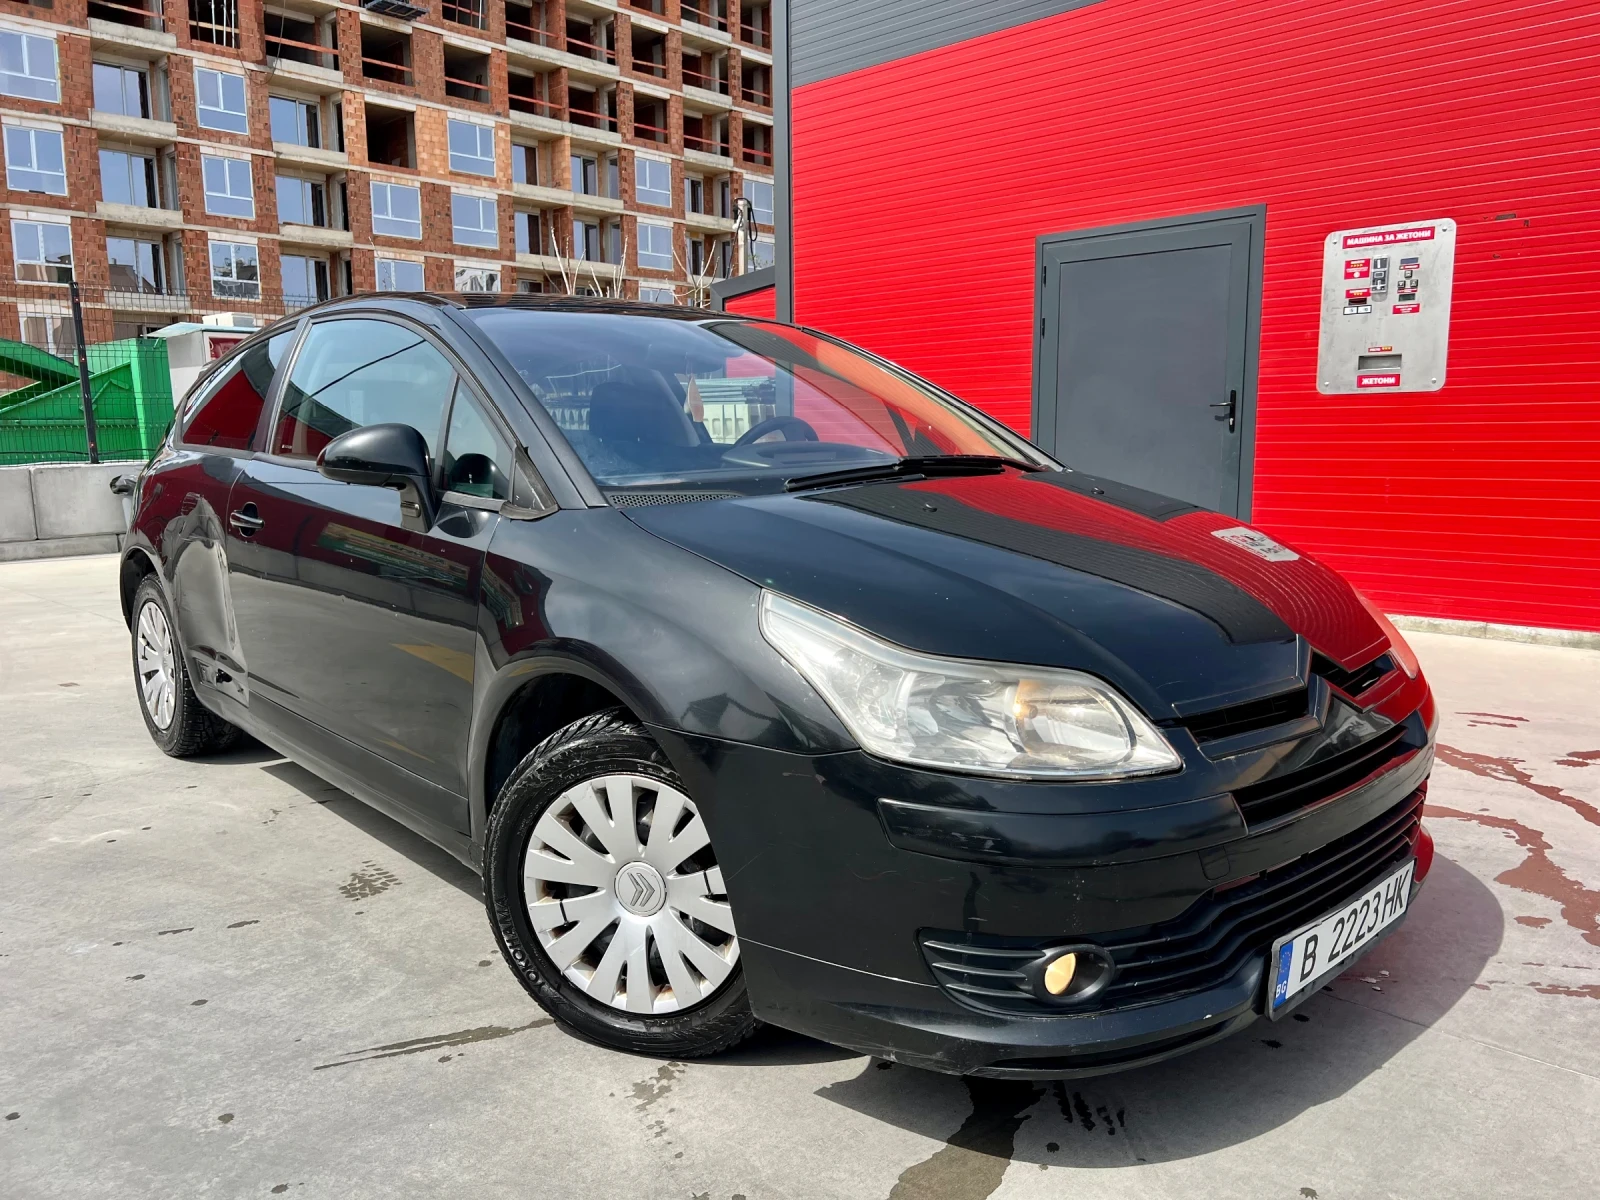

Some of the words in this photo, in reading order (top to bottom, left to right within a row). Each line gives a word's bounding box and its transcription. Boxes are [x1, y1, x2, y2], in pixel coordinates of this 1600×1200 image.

[1346, 235, 1383, 246] МАШИНА
[1384, 234, 1395, 242] ЗА
[1395, 230, 1431, 240] ЖЕТОНИ
[1361, 377, 1396, 385] ЖЕТОНИ
[1300, 934, 1318, 983] B
[1327, 891, 1381, 964] 2223
[1380, 869, 1409, 924] HK
[1275, 980, 1287, 998] BG
